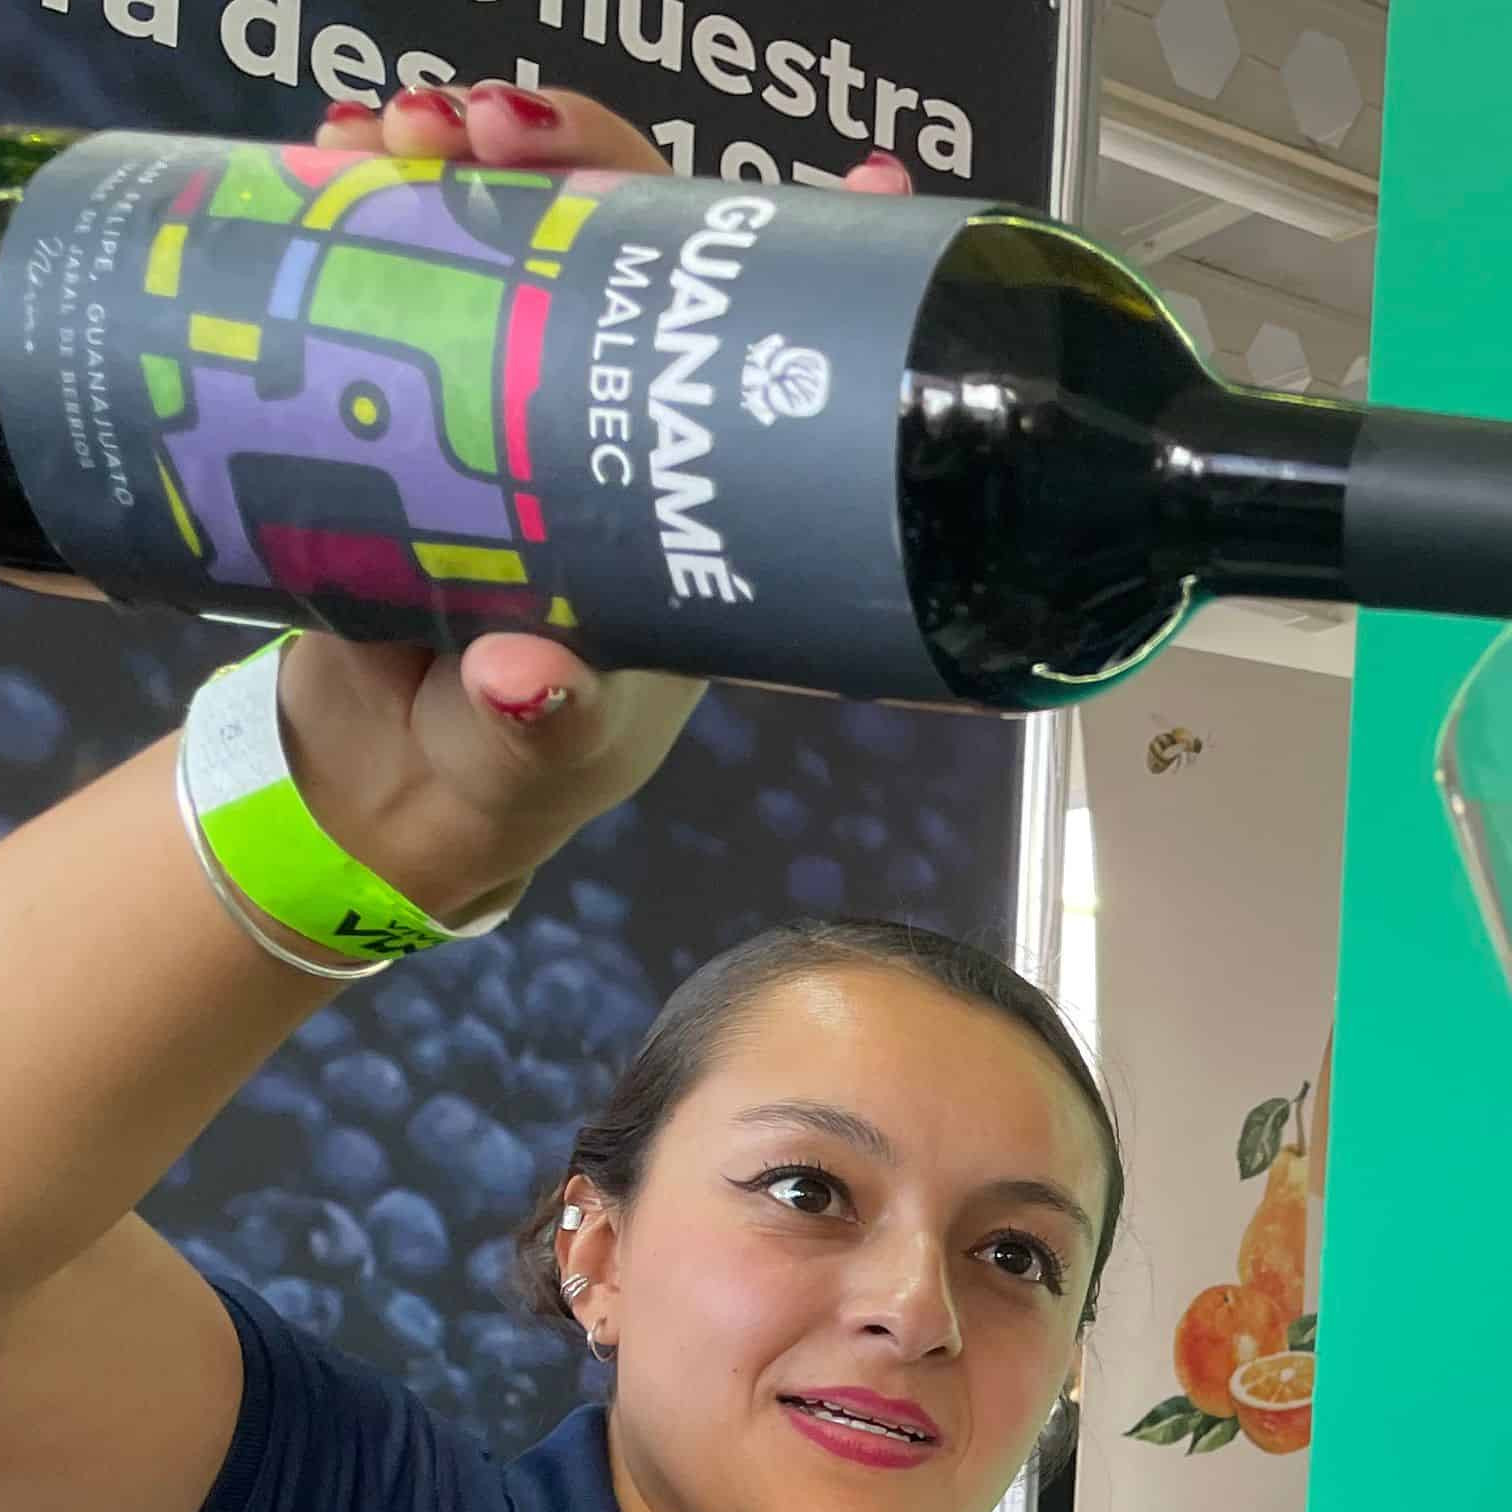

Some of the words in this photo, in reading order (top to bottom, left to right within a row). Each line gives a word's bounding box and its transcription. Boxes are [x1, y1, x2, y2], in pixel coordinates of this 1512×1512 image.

[84, 303, 135, 508] GUANAJUATO
[587, 242, 663, 488] MALBEC
[648, 194, 777, 604] GUANAMÉ
